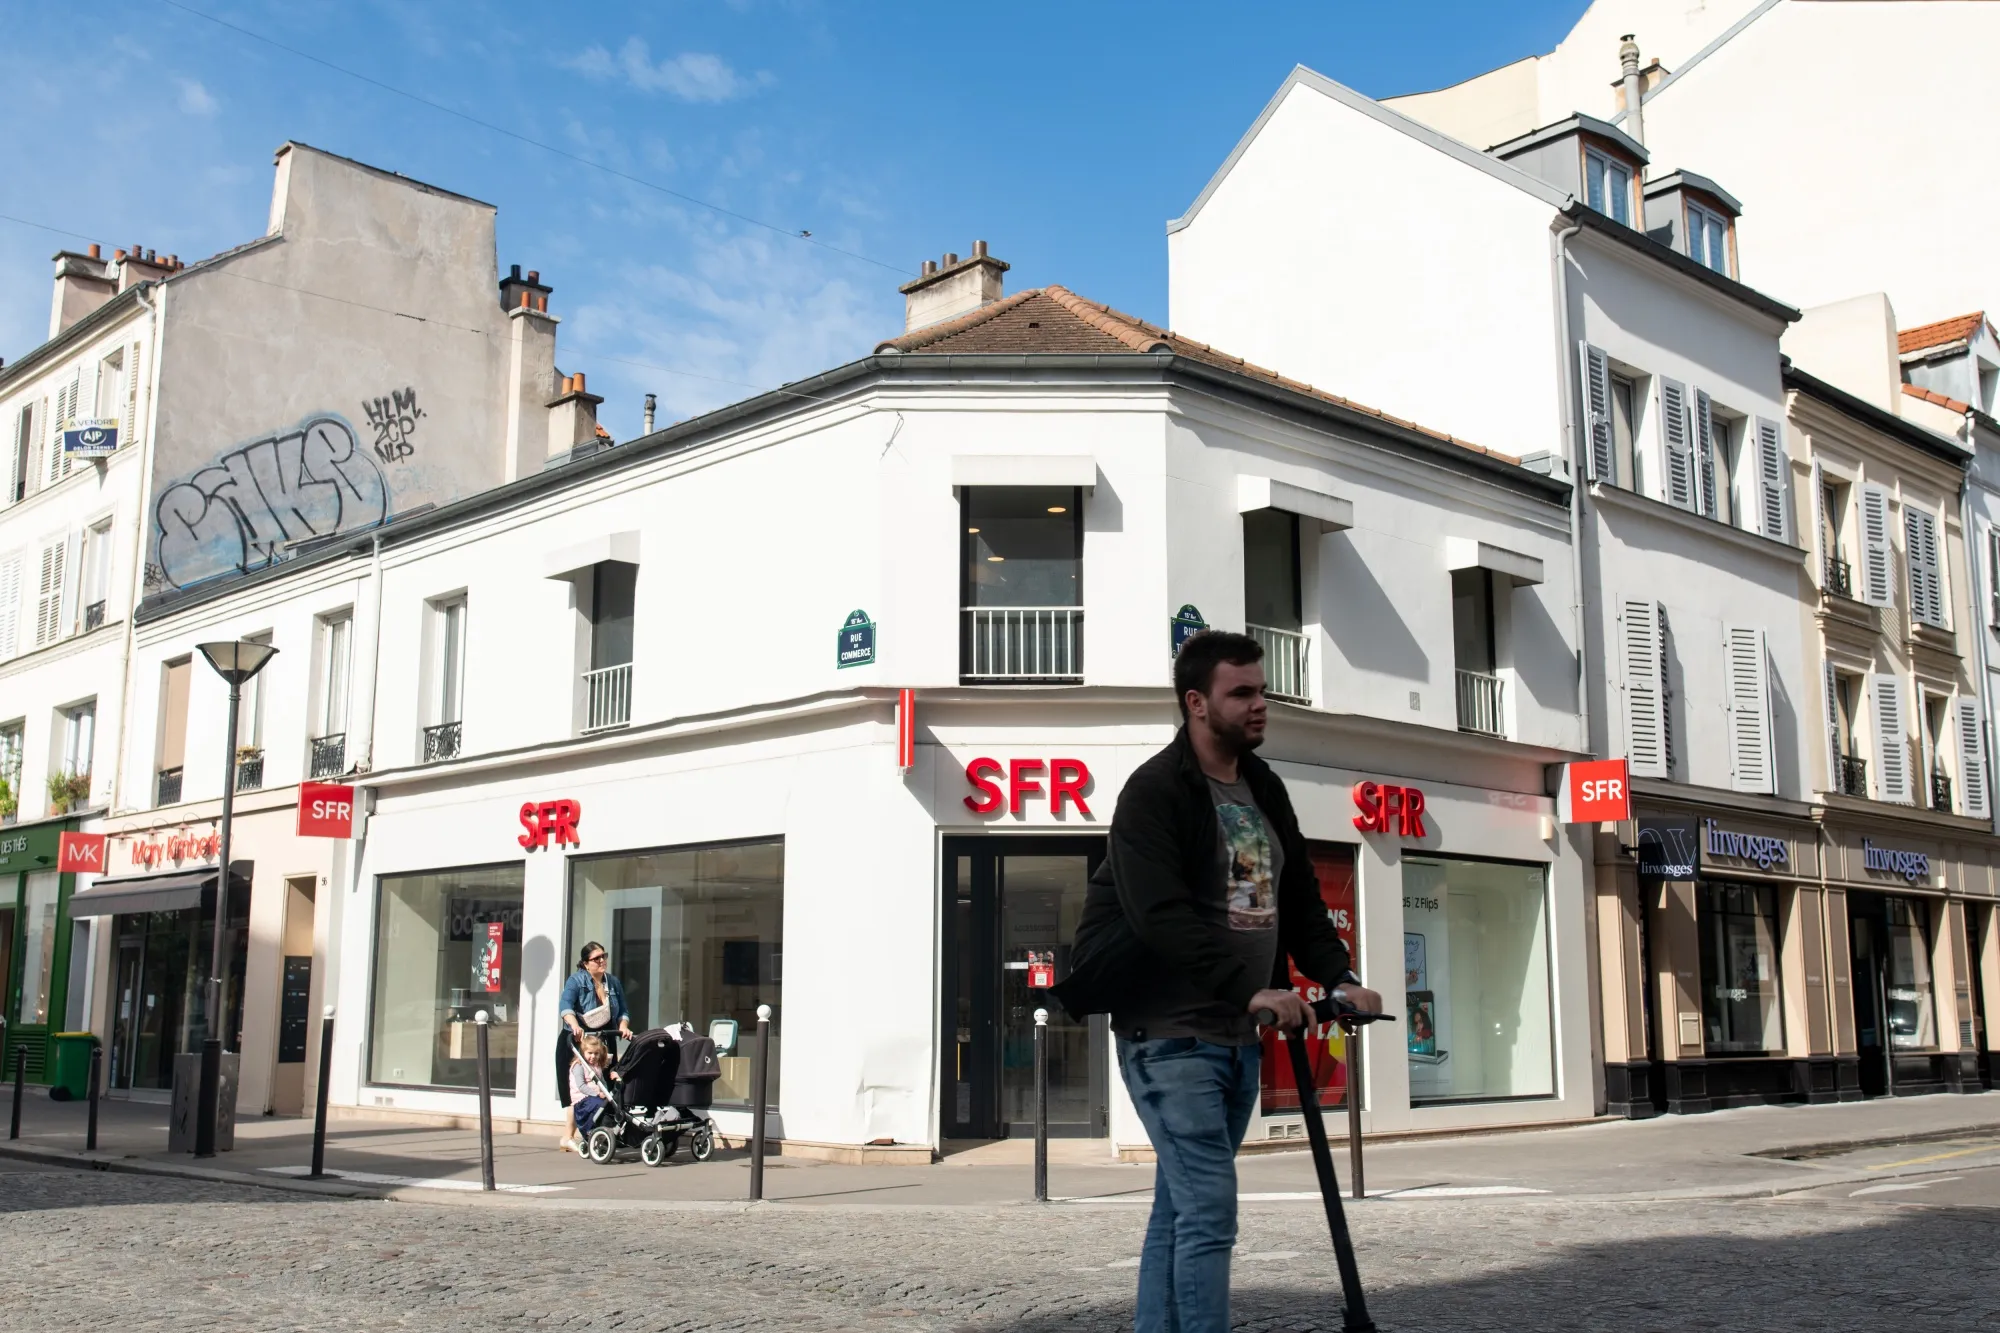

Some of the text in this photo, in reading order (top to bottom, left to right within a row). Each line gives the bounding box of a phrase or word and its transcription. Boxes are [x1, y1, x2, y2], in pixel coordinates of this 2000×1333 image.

[83, 430, 103, 443] AJP
[850, 632, 863, 643] RUE
[841, 647, 872, 661] COMMERCE
[963, 757, 1092, 813] SFR
[1581, 779, 1623, 802] SFR
[312, 799, 350, 821] SFR
[1352, 781, 1427, 838] SFR
[517, 799, 581, 848] SFR
[1, 839, 13, 855] DES
[69, 843, 99, 863] MK
[132, 840, 164, 868] Mary
[1705, 817, 1789, 870] linvosges
[1641, 861, 1693, 877] linvosges
[1863, 837, 1929, 881] linvosges
[1420, 897, 1439, 913] Flip5
